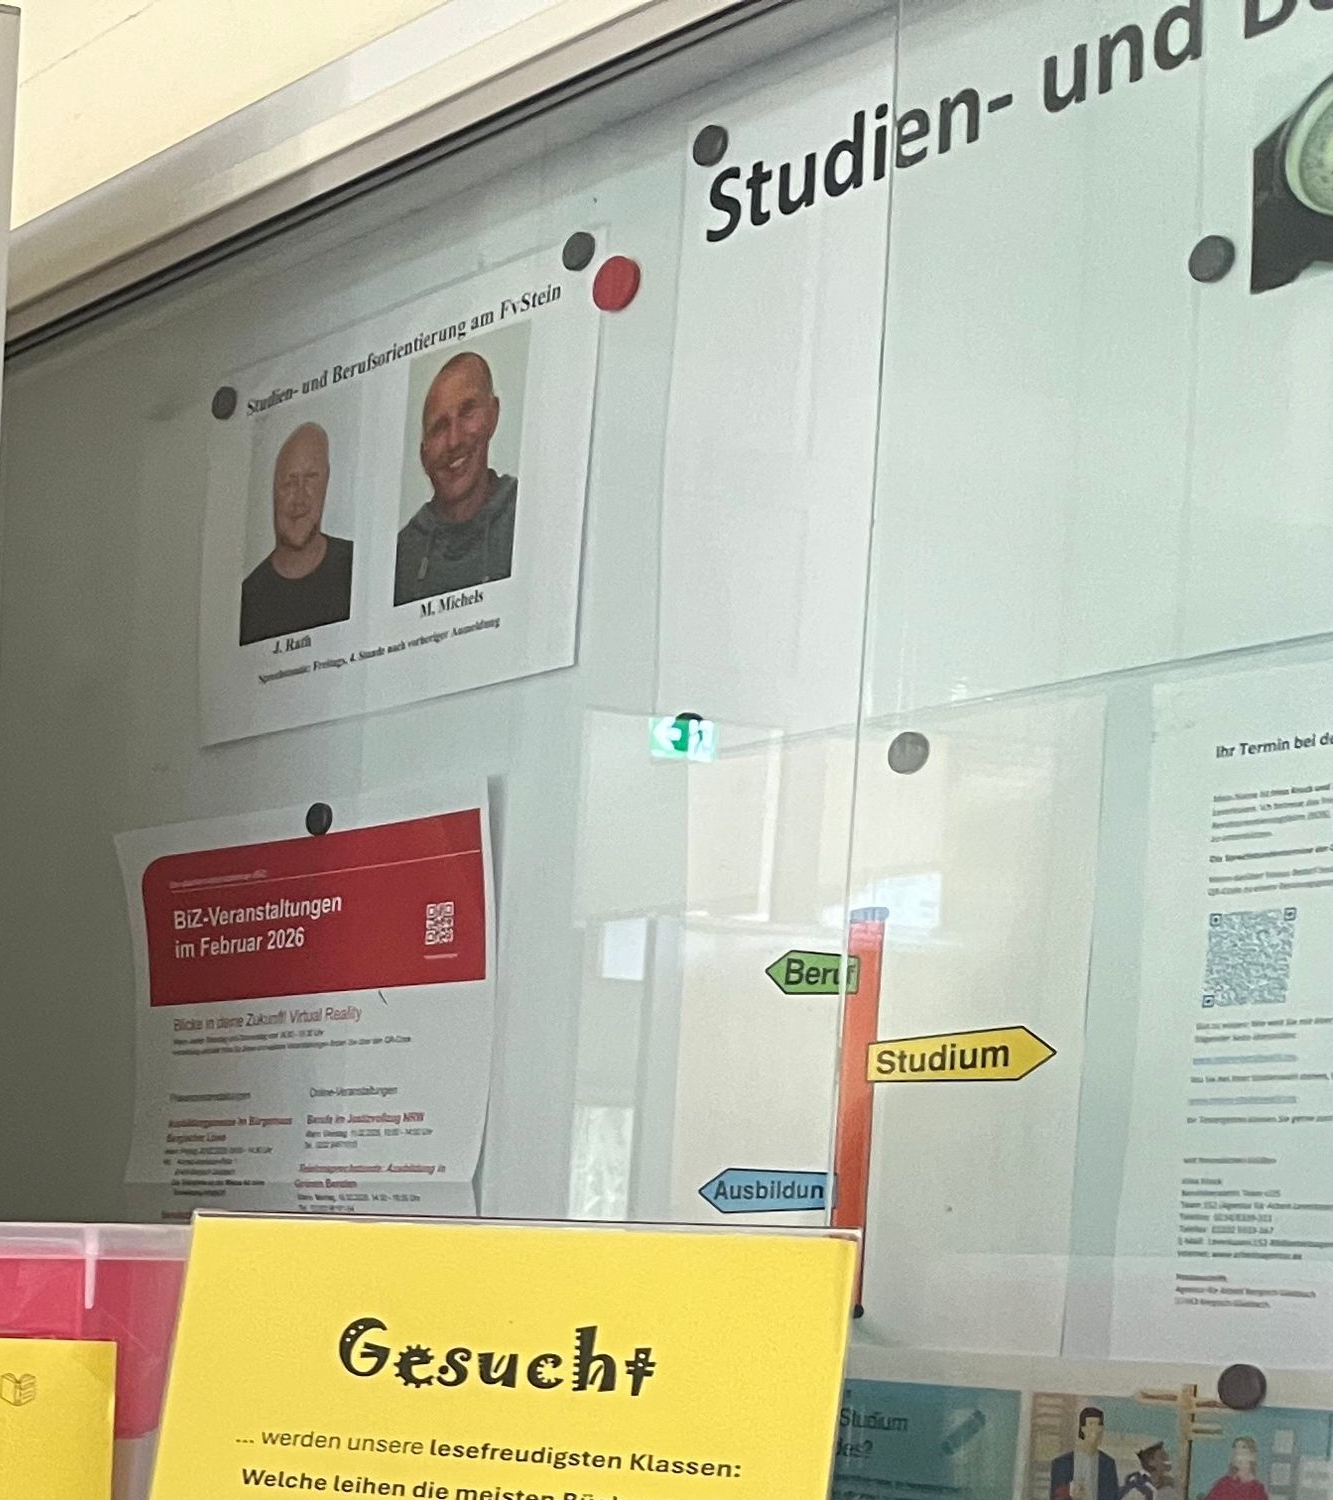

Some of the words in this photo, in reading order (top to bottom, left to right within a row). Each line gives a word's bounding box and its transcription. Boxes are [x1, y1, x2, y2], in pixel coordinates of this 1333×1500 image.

[706, 88, 1013, 242] Studien-
[1043, 0, 1202, 113] und
[301, 369, 328, 394] und
[332, 320, 467, 384] Berufsorientierung
[470, 310, 494, 331] am
[500, 283, 561, 320] FvStein
[1215, 745, 1236, 759] Ihr
[1239, 738, 1290, 756] Termin
[1293, 732, 1316, 749] bei
[173, 896, 342, 930] BiZ-Veranstaltungen
[175, 940, 195, 959] im
[200, 935, 263, 957] Februar
[266, 926, 305, 950] 2026
[876, 1043, 1010, 1075] Studium
[713, 1180, 825, 1201] Ausbildun
[338, 1317, 657, 1397] Gesucht
[261, 1430, 341, 1450] werden
[347, 1437, 424, 1455] unsere
[429, 1438, 622, 1470] lesefreudigsten
[629, 1452, 741, 1478] Klassen:
[242, 1468, 328, 1491] Welche
[333, 1474, 406, 1497] leihen
[412, 1480, 449, 1500] die
